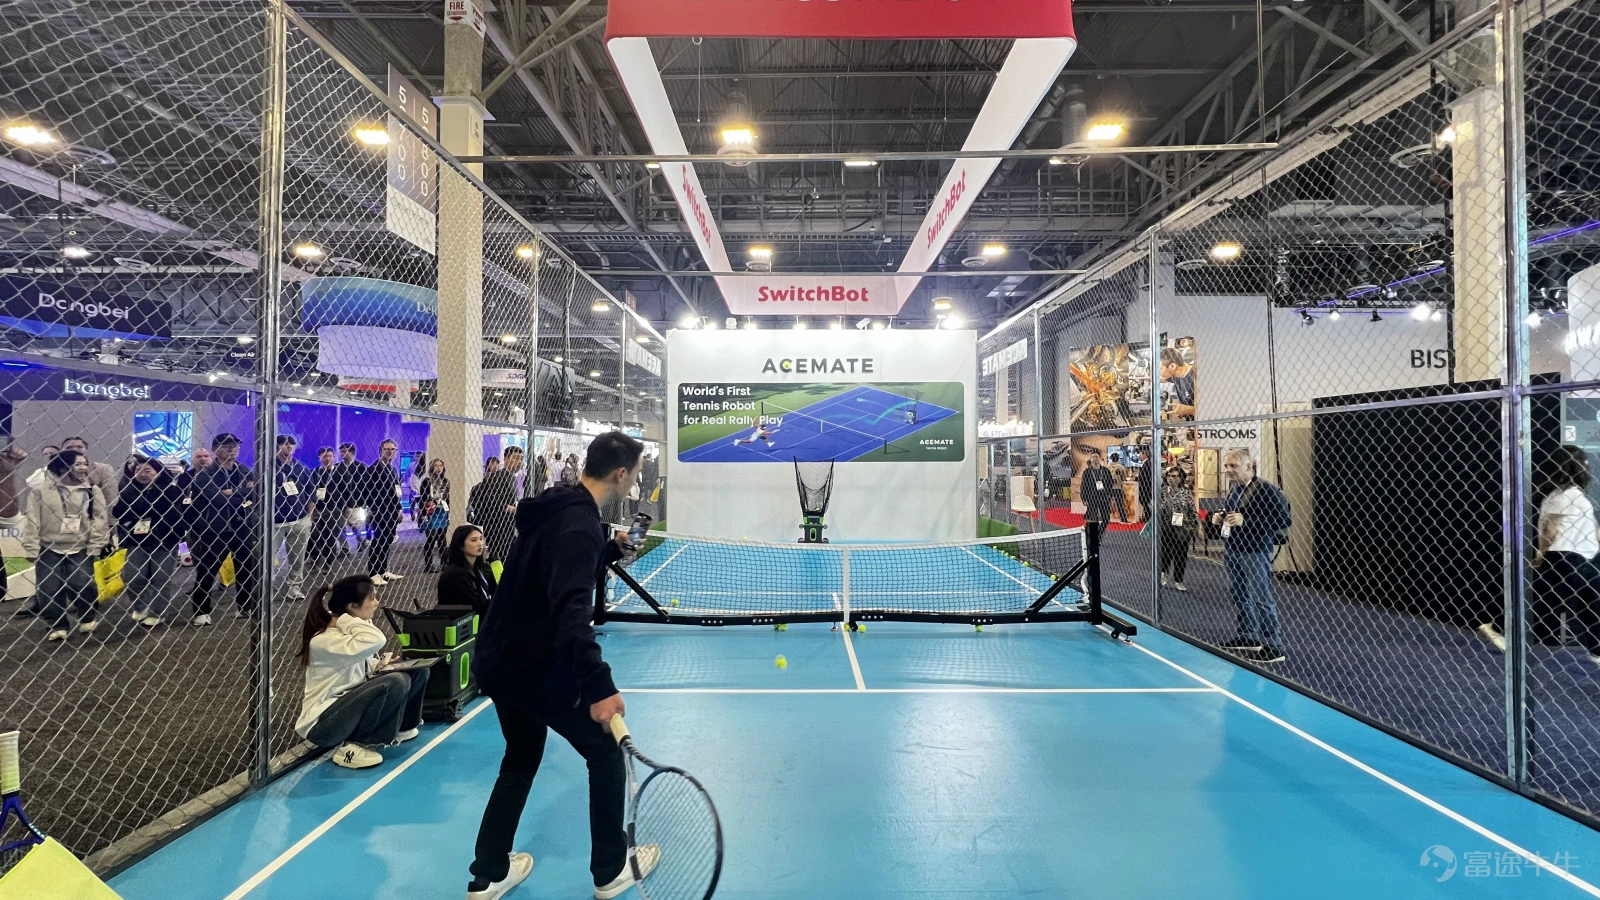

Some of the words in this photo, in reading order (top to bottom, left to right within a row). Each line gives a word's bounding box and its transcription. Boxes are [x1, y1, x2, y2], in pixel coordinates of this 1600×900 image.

[449, 1, 465, 10] FIRE
[397, 85, 407, 181] 5700
[421, 107, 429, 197] 5800
[927, 168, 966, 250] SwitchBot
[758, 285, 869, 302] SwitchBot
[762, 358, 874, 374] ACEMATE
[682, 386, 725, 396] World's
[726, 386, 751, 396] First
[683, 401, 720, 411] Tennis
[722, 401, 756, 411] Robot
[683, 415, 700, 425] for
[701, 415, 727, 425] Real
[730, 415, 755, 428] Rally
[759, 415, 784, 428] Play
